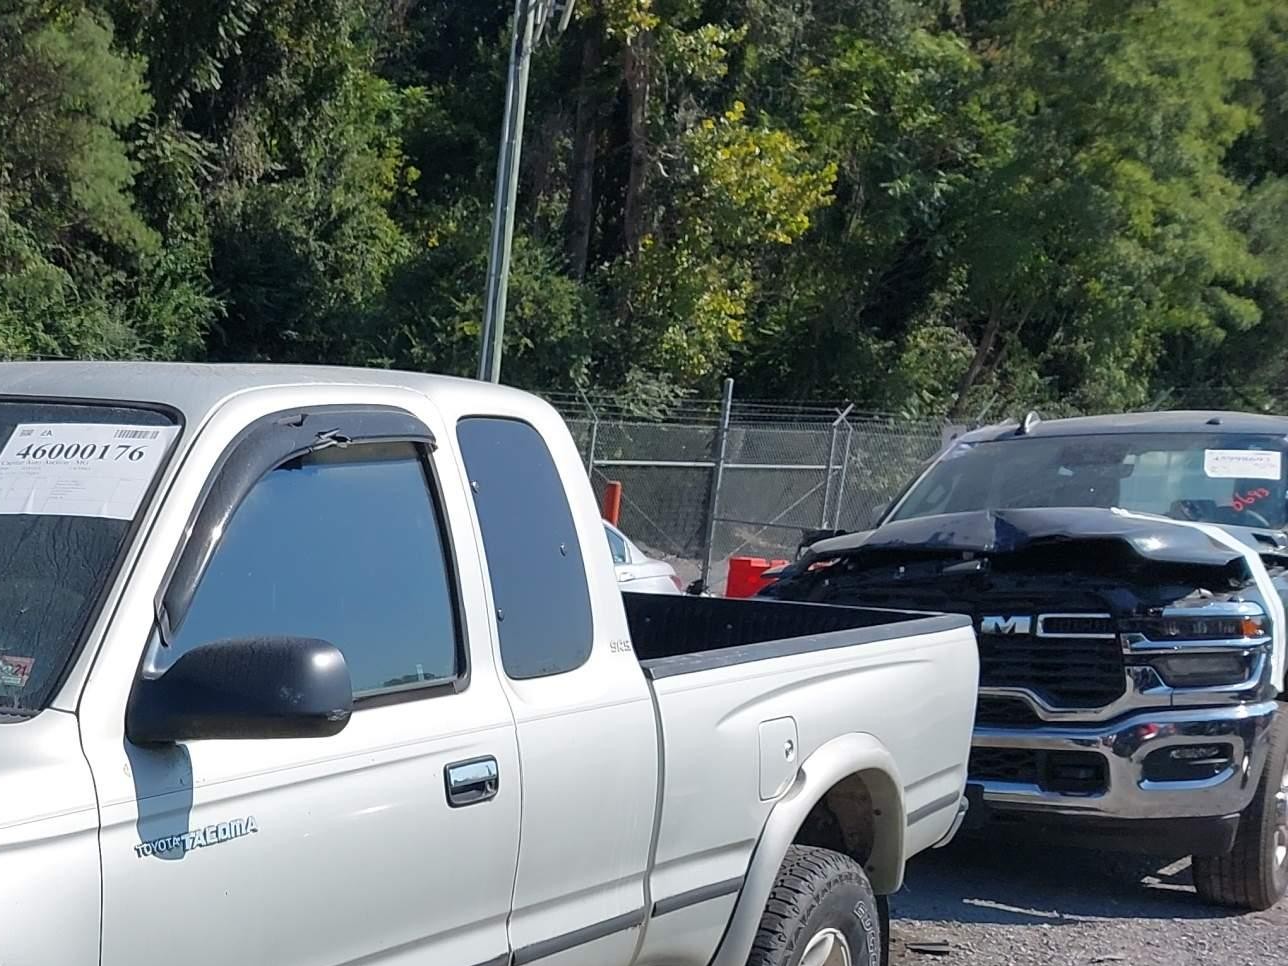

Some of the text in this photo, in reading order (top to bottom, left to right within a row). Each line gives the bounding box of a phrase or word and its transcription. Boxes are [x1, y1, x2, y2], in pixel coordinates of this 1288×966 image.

[16, 443, 148, 462] 46000176
[609, 639, 631, 653] SR5
[134, 816, 259, 858] TOYOTA TACOMA
